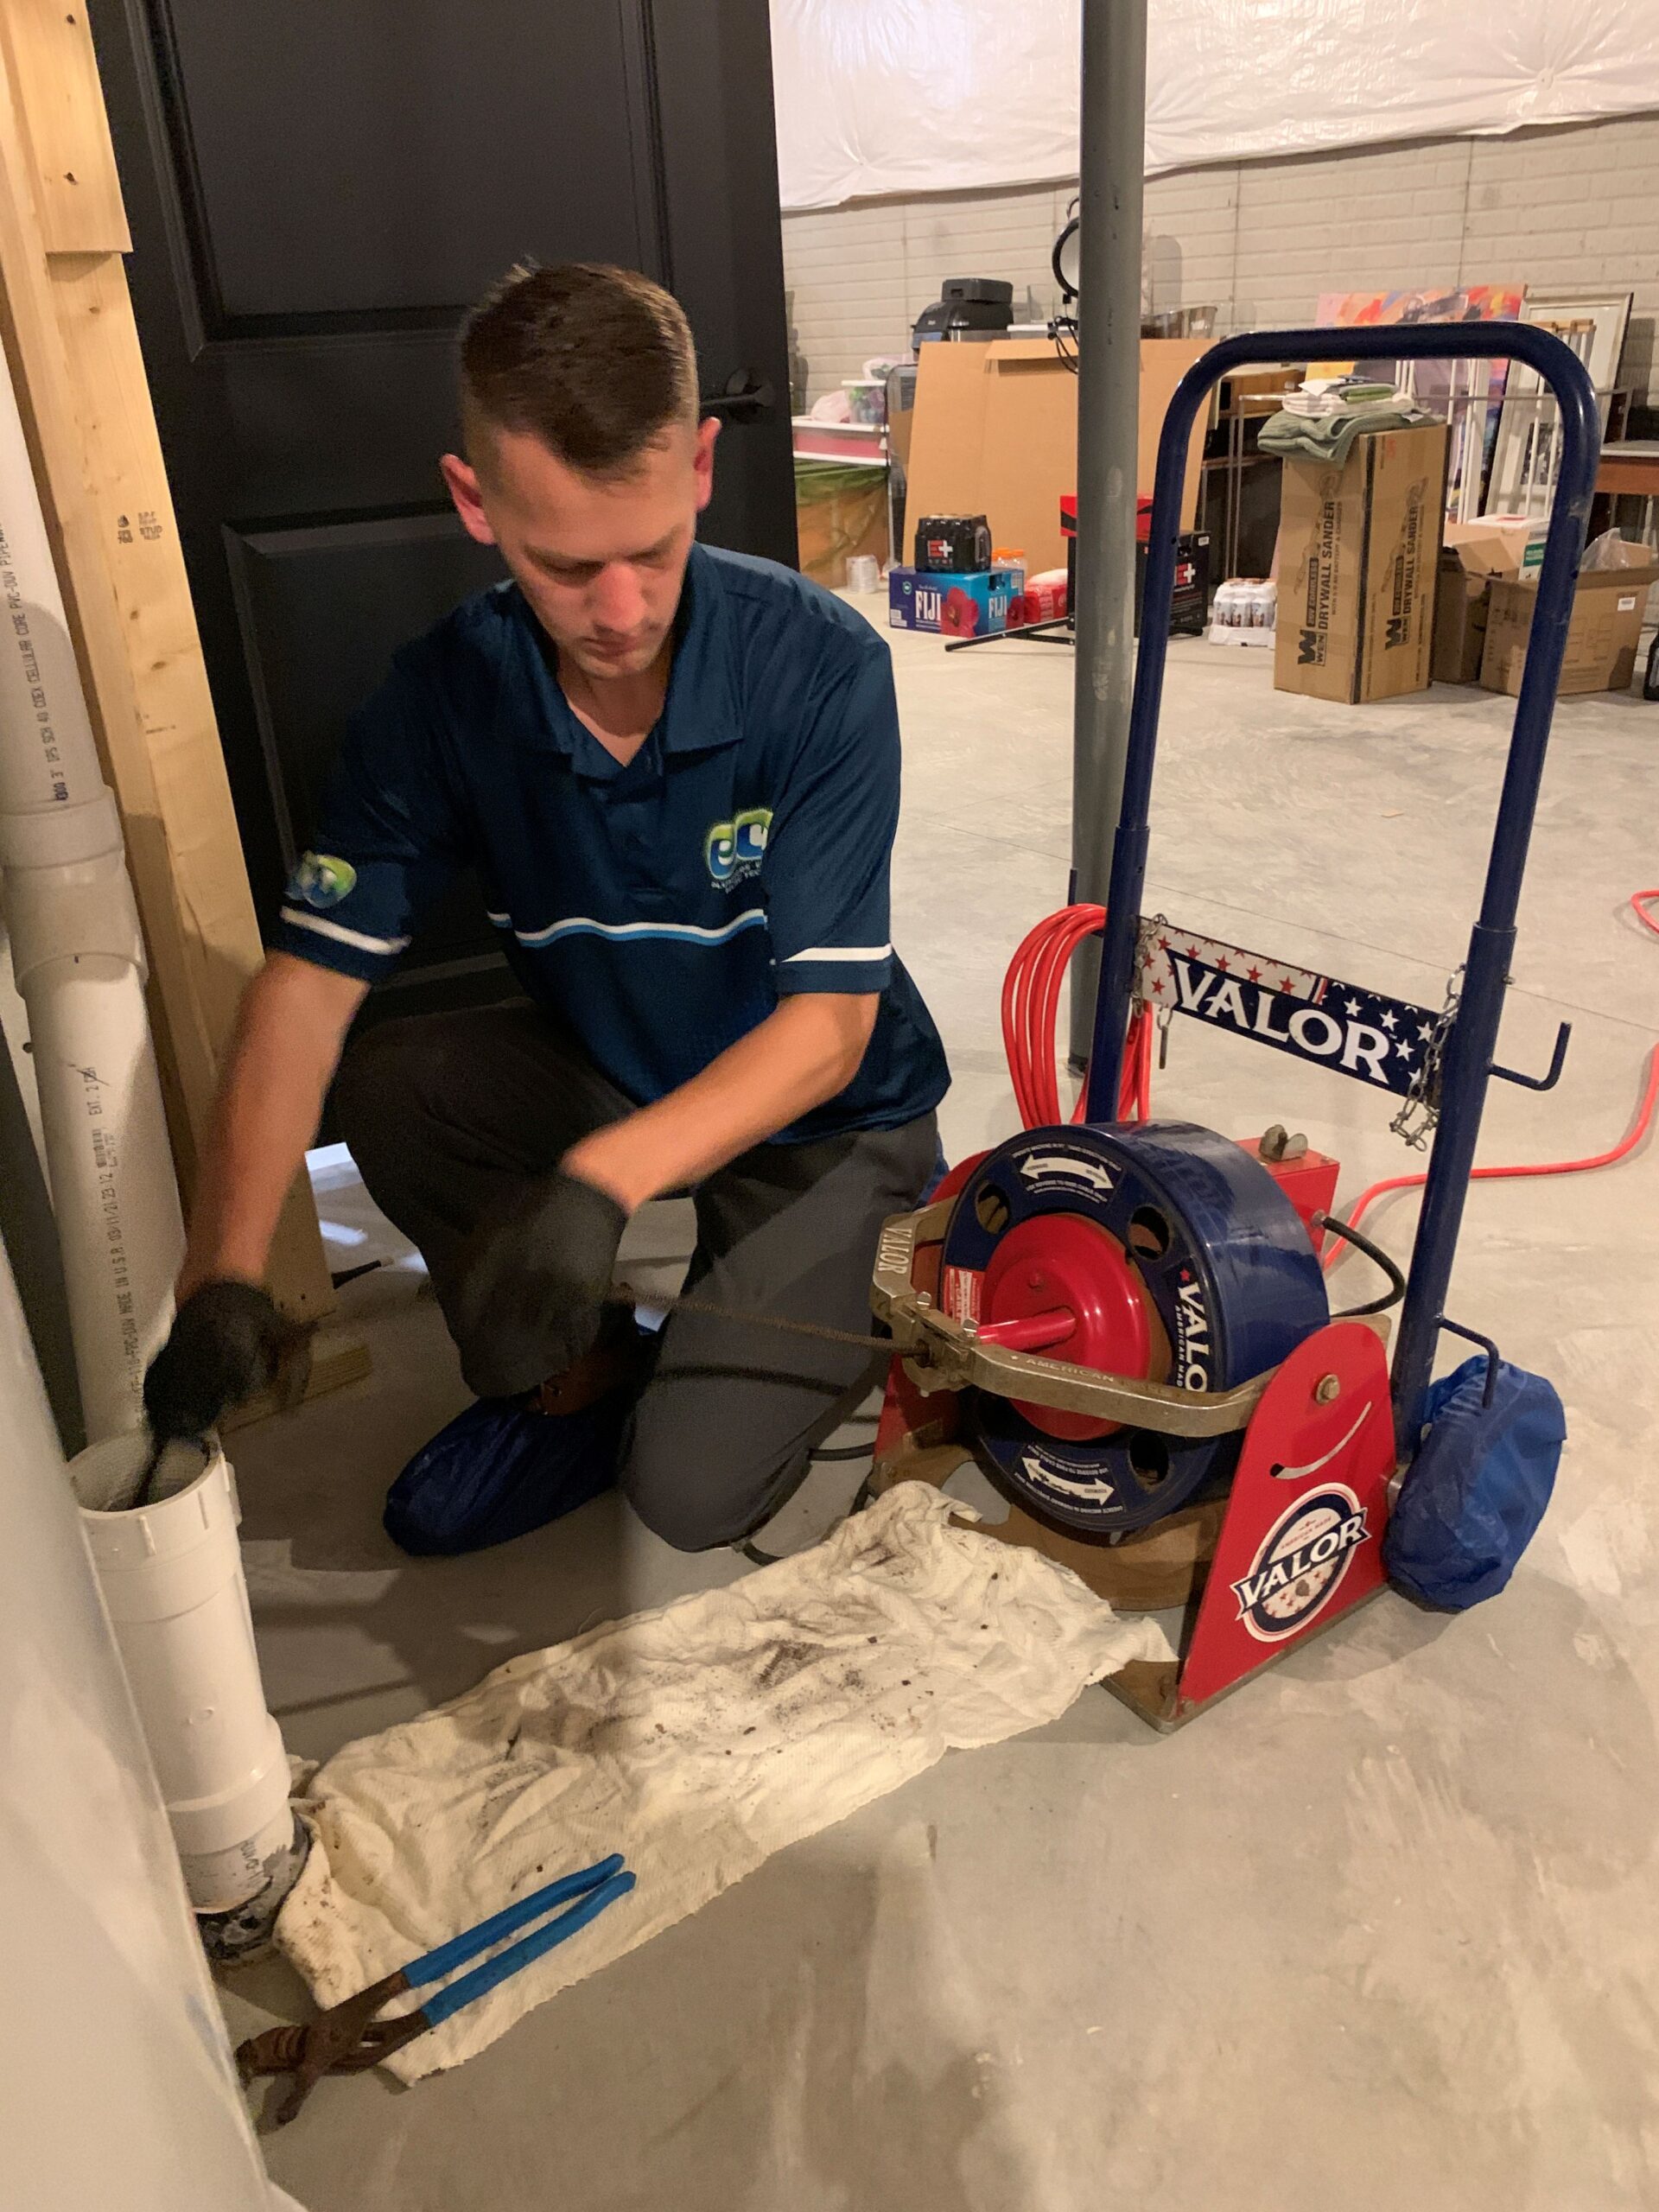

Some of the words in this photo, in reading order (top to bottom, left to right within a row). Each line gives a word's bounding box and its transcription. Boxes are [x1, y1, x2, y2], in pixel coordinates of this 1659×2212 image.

[1322, 502, 1335, 559] SANDER
[1407, 505, 1418, 555] SANDER
[914, 590, 942, 621] FIJI
[988, 594, 1007, 620] FIJI
[1318, 563, 1331, 630] DRYWALL
[1403, 557, 1415, 614] DRYWALL
[12, 613, 29, 636] CORE
[1316, 634, 1325, 663] WEN
[1173, 957, 1389, 1085] VALOR
[878, 1227, 912, 1274] VALOR
[1174, 1305, 1185, 1361] AMERICAN
[1178, 1281, 1210, 1393] VALO
[1026, 1357, 1115, 1382] AMERICAN
[1176, 1363, 1185, 1388] MAD
[1240, 1515, 1363, 1610] VALOR
